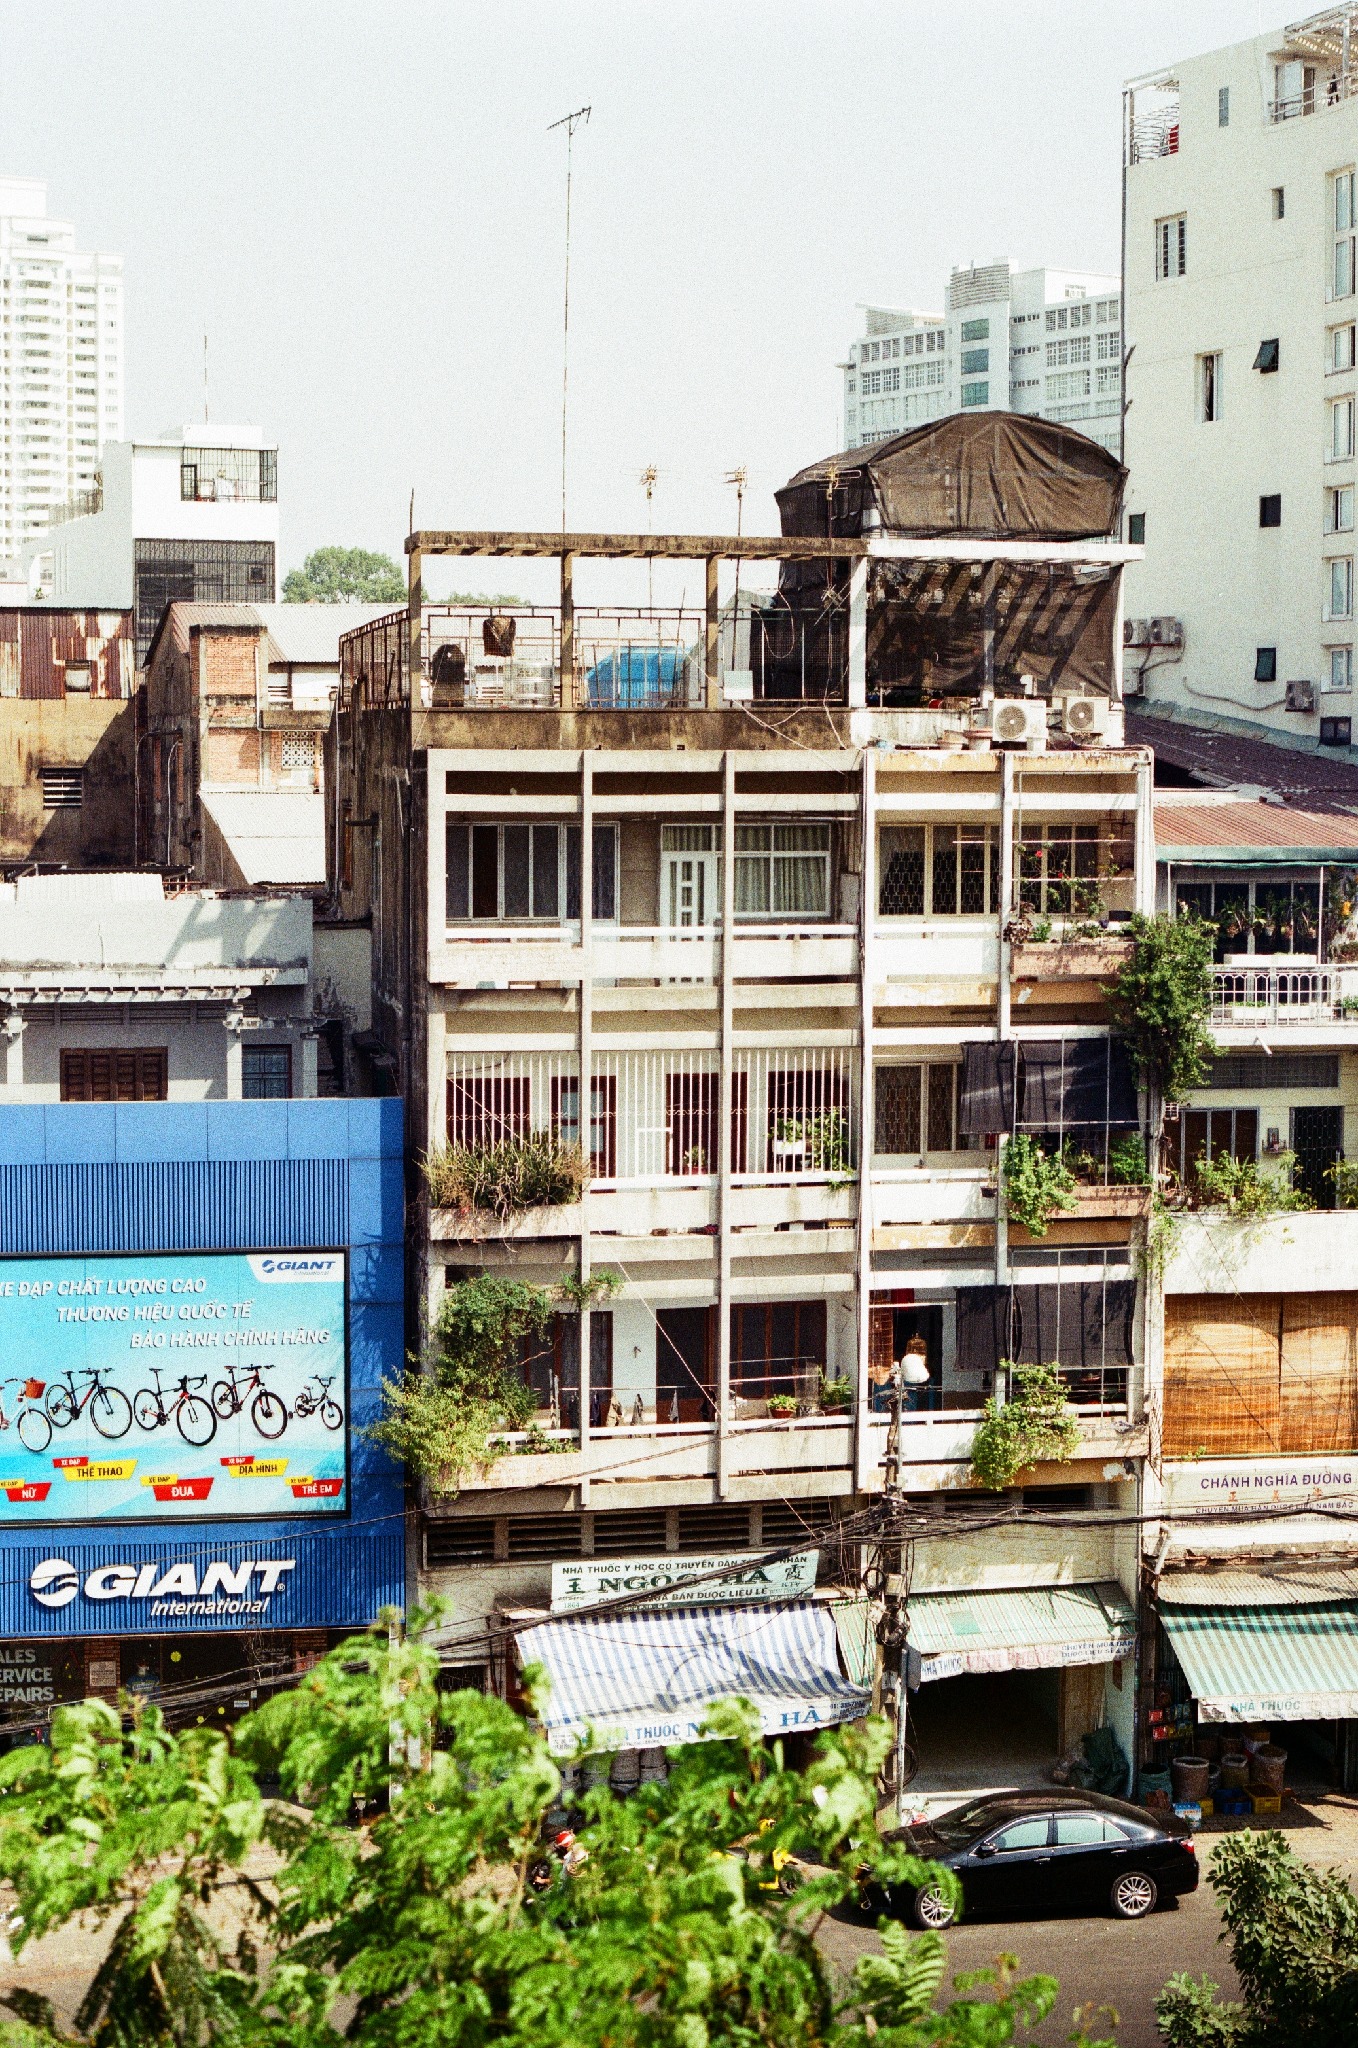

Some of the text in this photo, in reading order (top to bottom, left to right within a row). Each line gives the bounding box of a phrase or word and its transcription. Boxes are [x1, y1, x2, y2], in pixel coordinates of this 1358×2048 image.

[277, 1261, 336, 1271] GIANT
[17, 1281, 54, 1300] ĐẠP
[57, 1275, 103, 1296] CHẤT
[106, 1278, 167, 1298] LƯỢNG
[170, 1278, 207, 1294] CAO
[57, 1298, 255, 1323] THƯƠNG HIỆU QUỐC TẾ
[170, 1330, 220, 1348] HÀNH
[223, 1327, 278, 1347] CHÍNH
[97, 1467, 123, 1477] THAO
[256, 1463, 278, 1473] HÌNH
[302, 1483, 333, 1494] TRẺ EM
[1201, 1471, 1352, 1489] CHÁNH NGHĨA ĐƯỜNG
[21, 1487, 37, 1499] NỮ
[171, 1486, 195, 1497] ĐUA
[84, 1559, 297, 1600] GIANT
[151, 1596, 271, 1616] International
[0, 1667, 53, 1683] RVICE
[779, 1705, 822, 1727] HÀ
